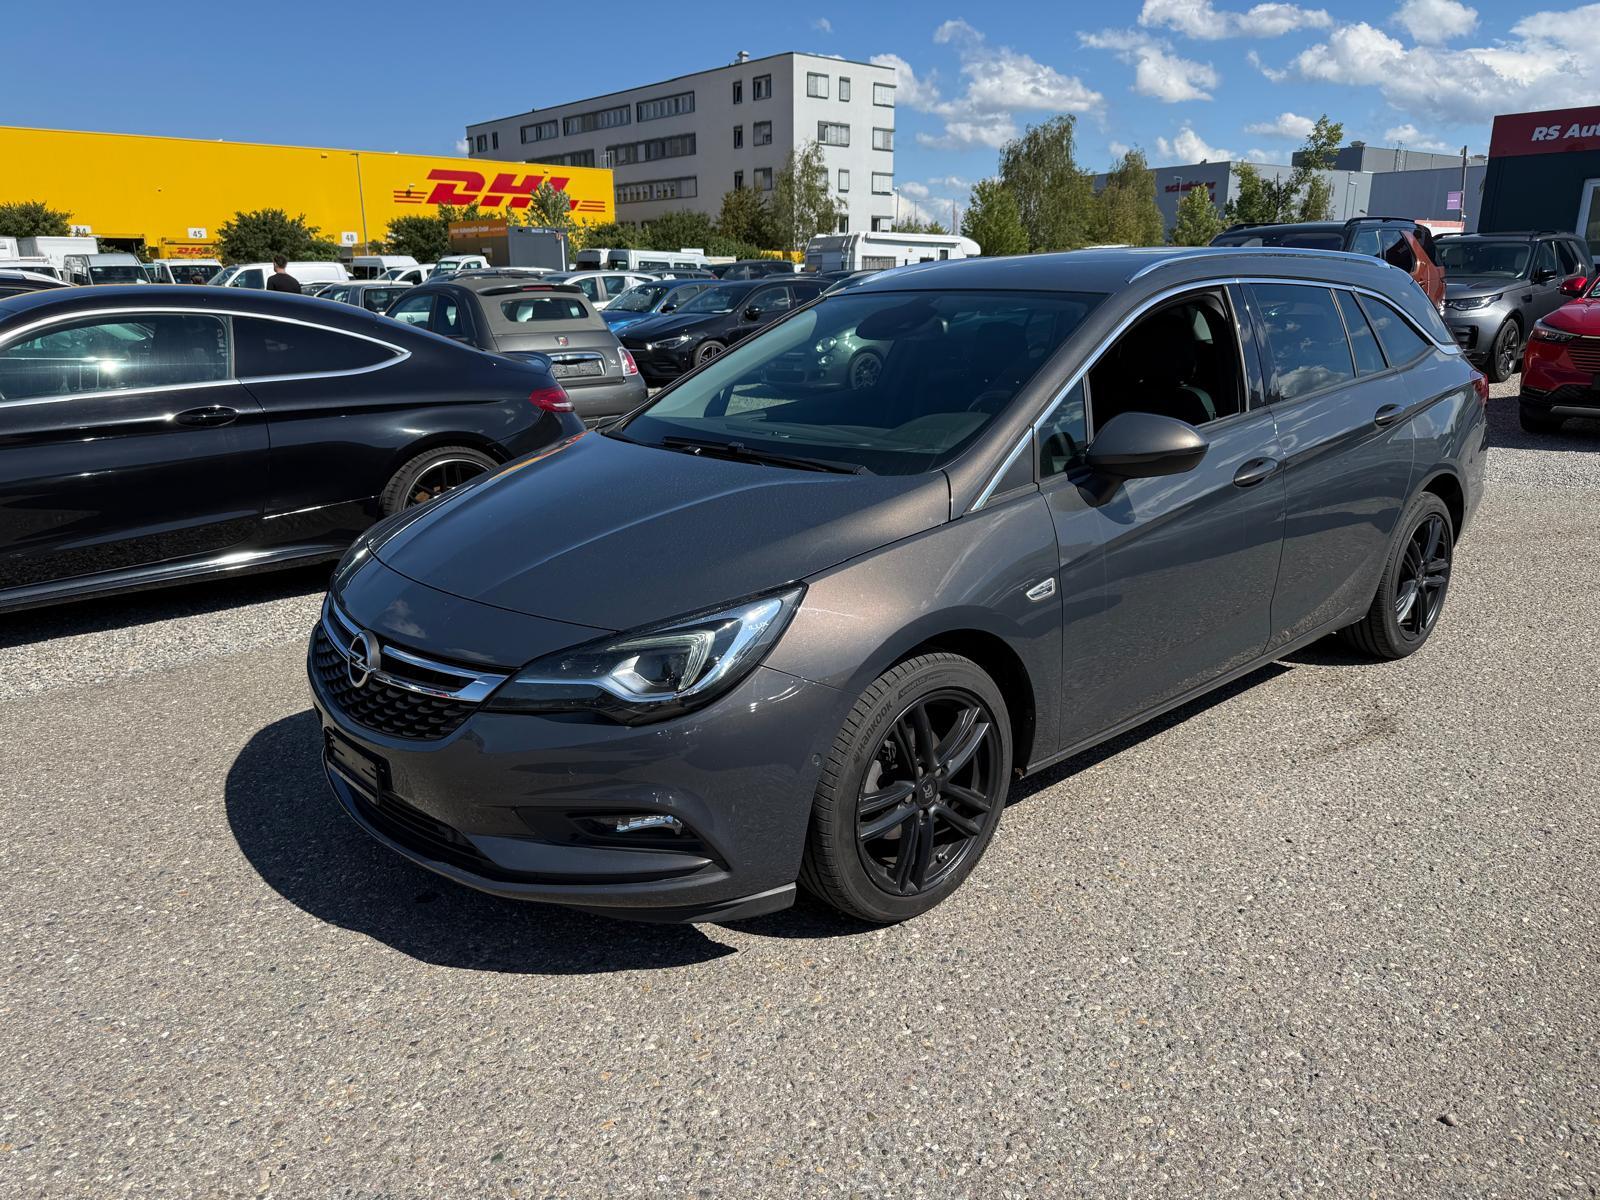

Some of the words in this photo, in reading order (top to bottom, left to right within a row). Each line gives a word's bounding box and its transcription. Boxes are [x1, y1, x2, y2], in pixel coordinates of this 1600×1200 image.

[1531, 124, 1561, 142] RS
[426, 169, 579, 210] DHL
[192, 230, 203, 238] 45
